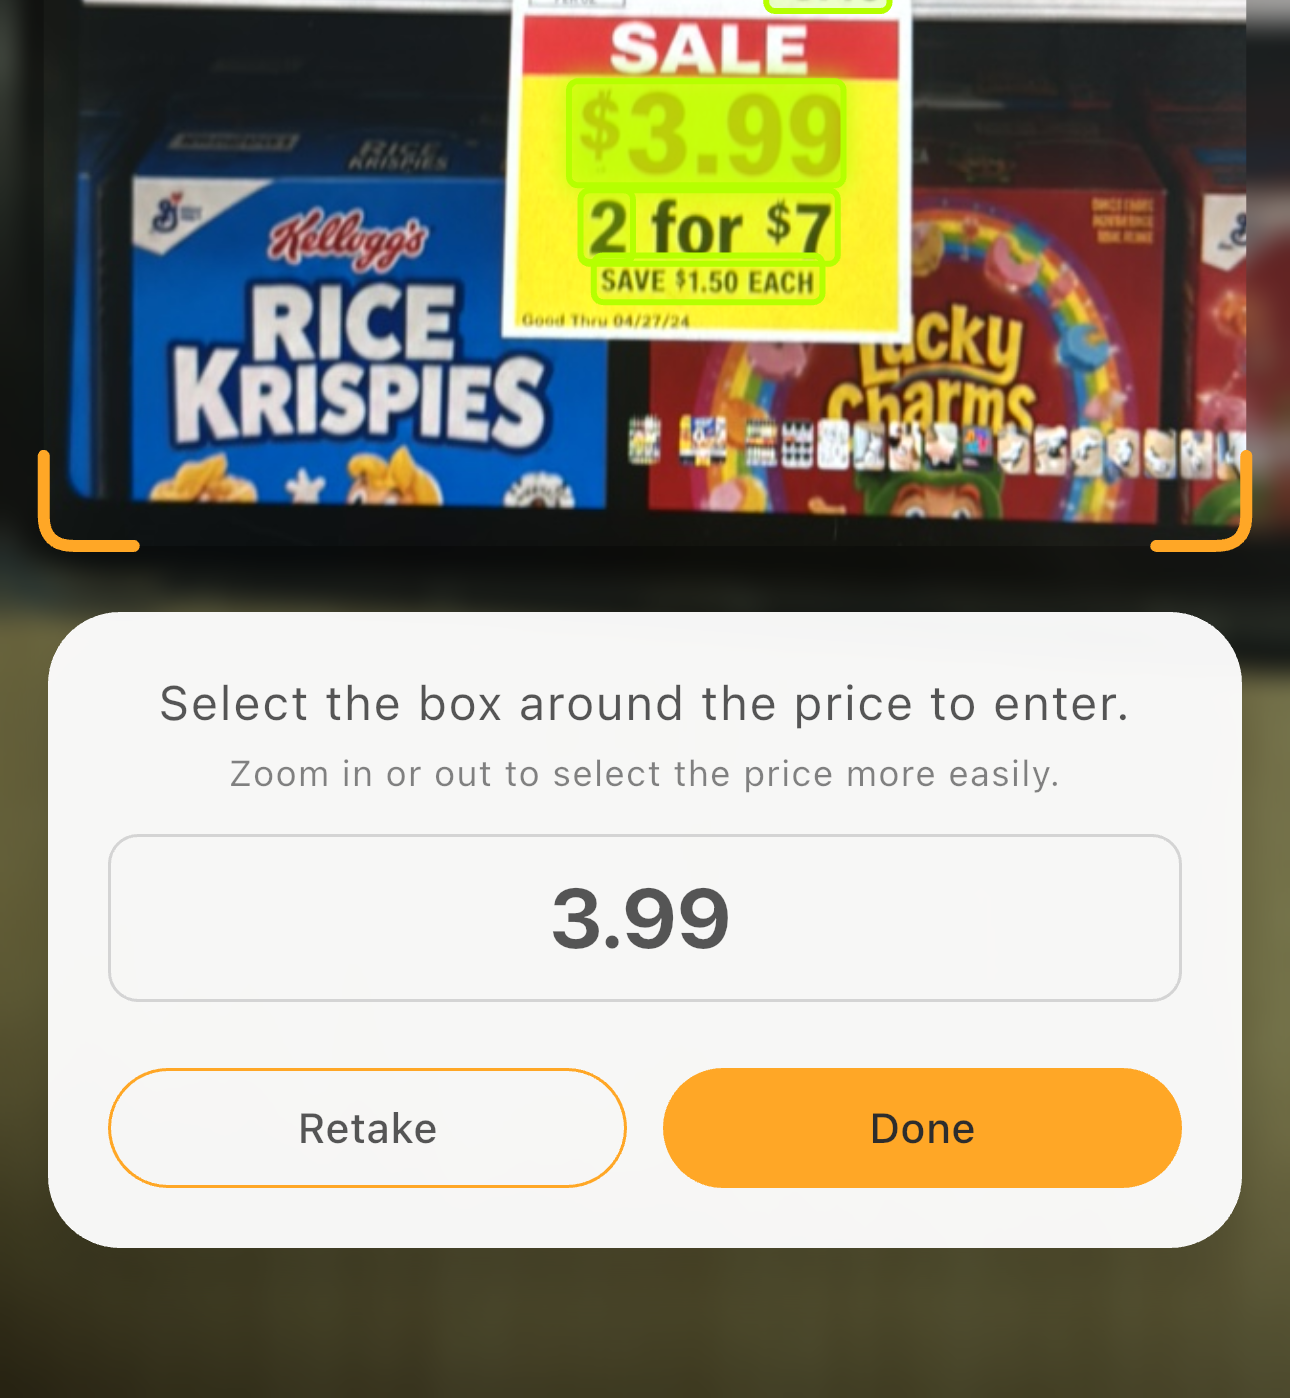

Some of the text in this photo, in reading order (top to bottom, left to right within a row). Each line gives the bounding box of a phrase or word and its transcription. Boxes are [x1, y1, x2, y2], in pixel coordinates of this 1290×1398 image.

[610, 20, 808, 76] SALE
[579, 88, 842, 177] $3.99
[267, 206, 429, 274] Kellogg's
[589, 199, 832, 257] 2 for $7
[601, 268, 814, 295] SAVE $1.50 EACH
[251, 283, 456, 362] RICE
[521, 313, 690, 330] Good Thru 04/27/24
[173, 345, 547, 450] KRISPIES
[161, 684, 1126, 729] Select the box around the price to enter.
[231, 759, 1057, 793] Zoom in or out to select the price more easily.
[553, 888, 728, 949] 3.99
[300, 1112, 436, 1144] Retake
[872, 1112, 975, 1144] Done
